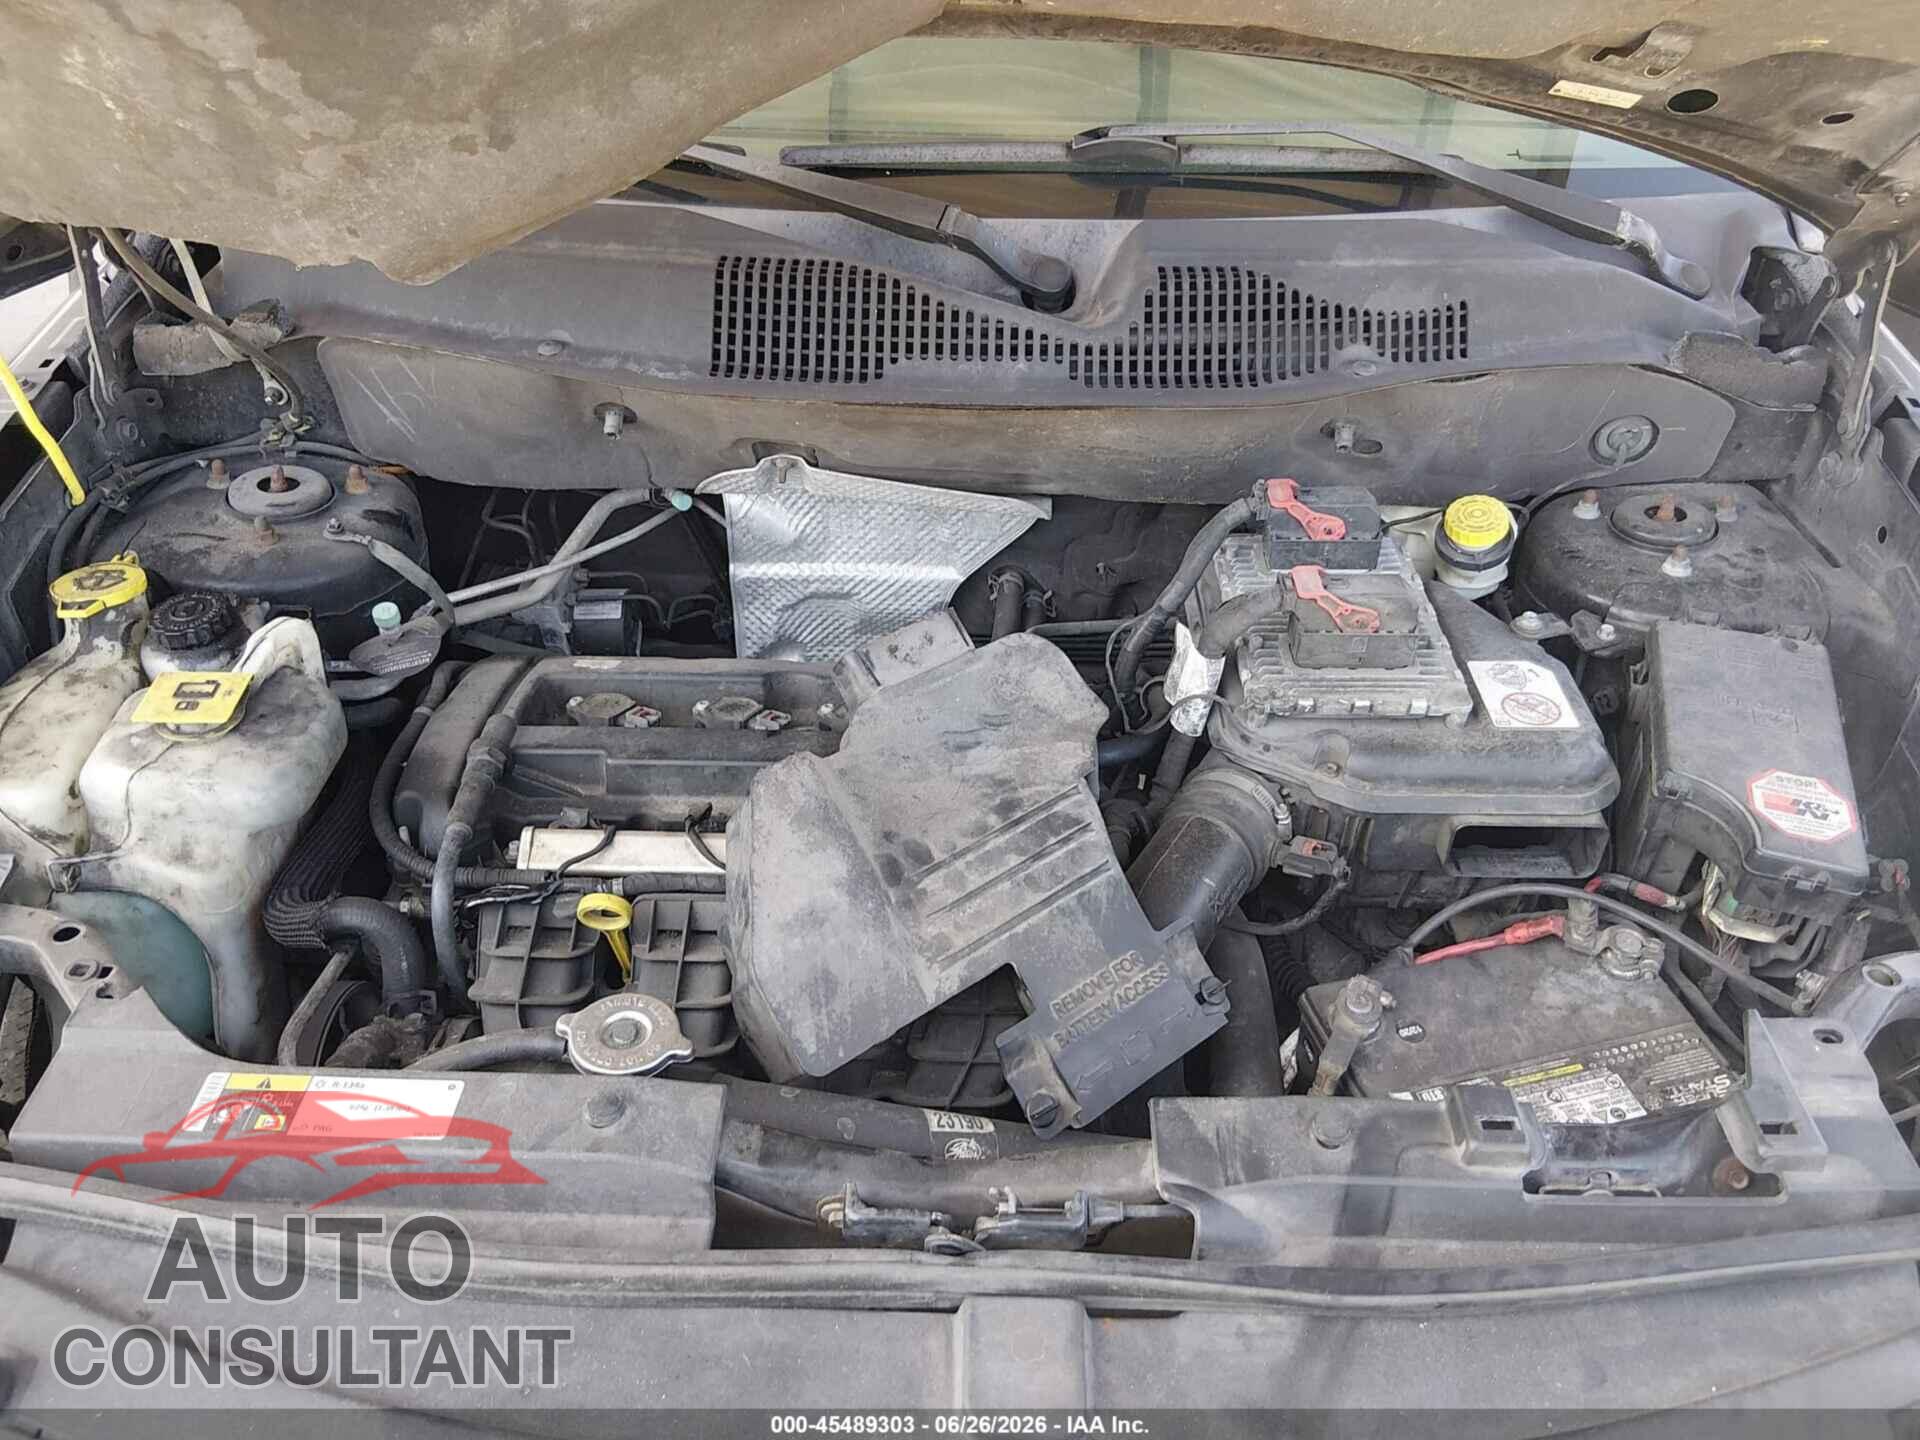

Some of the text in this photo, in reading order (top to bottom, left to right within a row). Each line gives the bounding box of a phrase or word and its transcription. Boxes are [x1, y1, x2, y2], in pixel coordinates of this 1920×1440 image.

[1049, 950, 1144, 1021] REMOVE FOR
[1050, 961, 1169, 1050] BATTERY ACCESS
